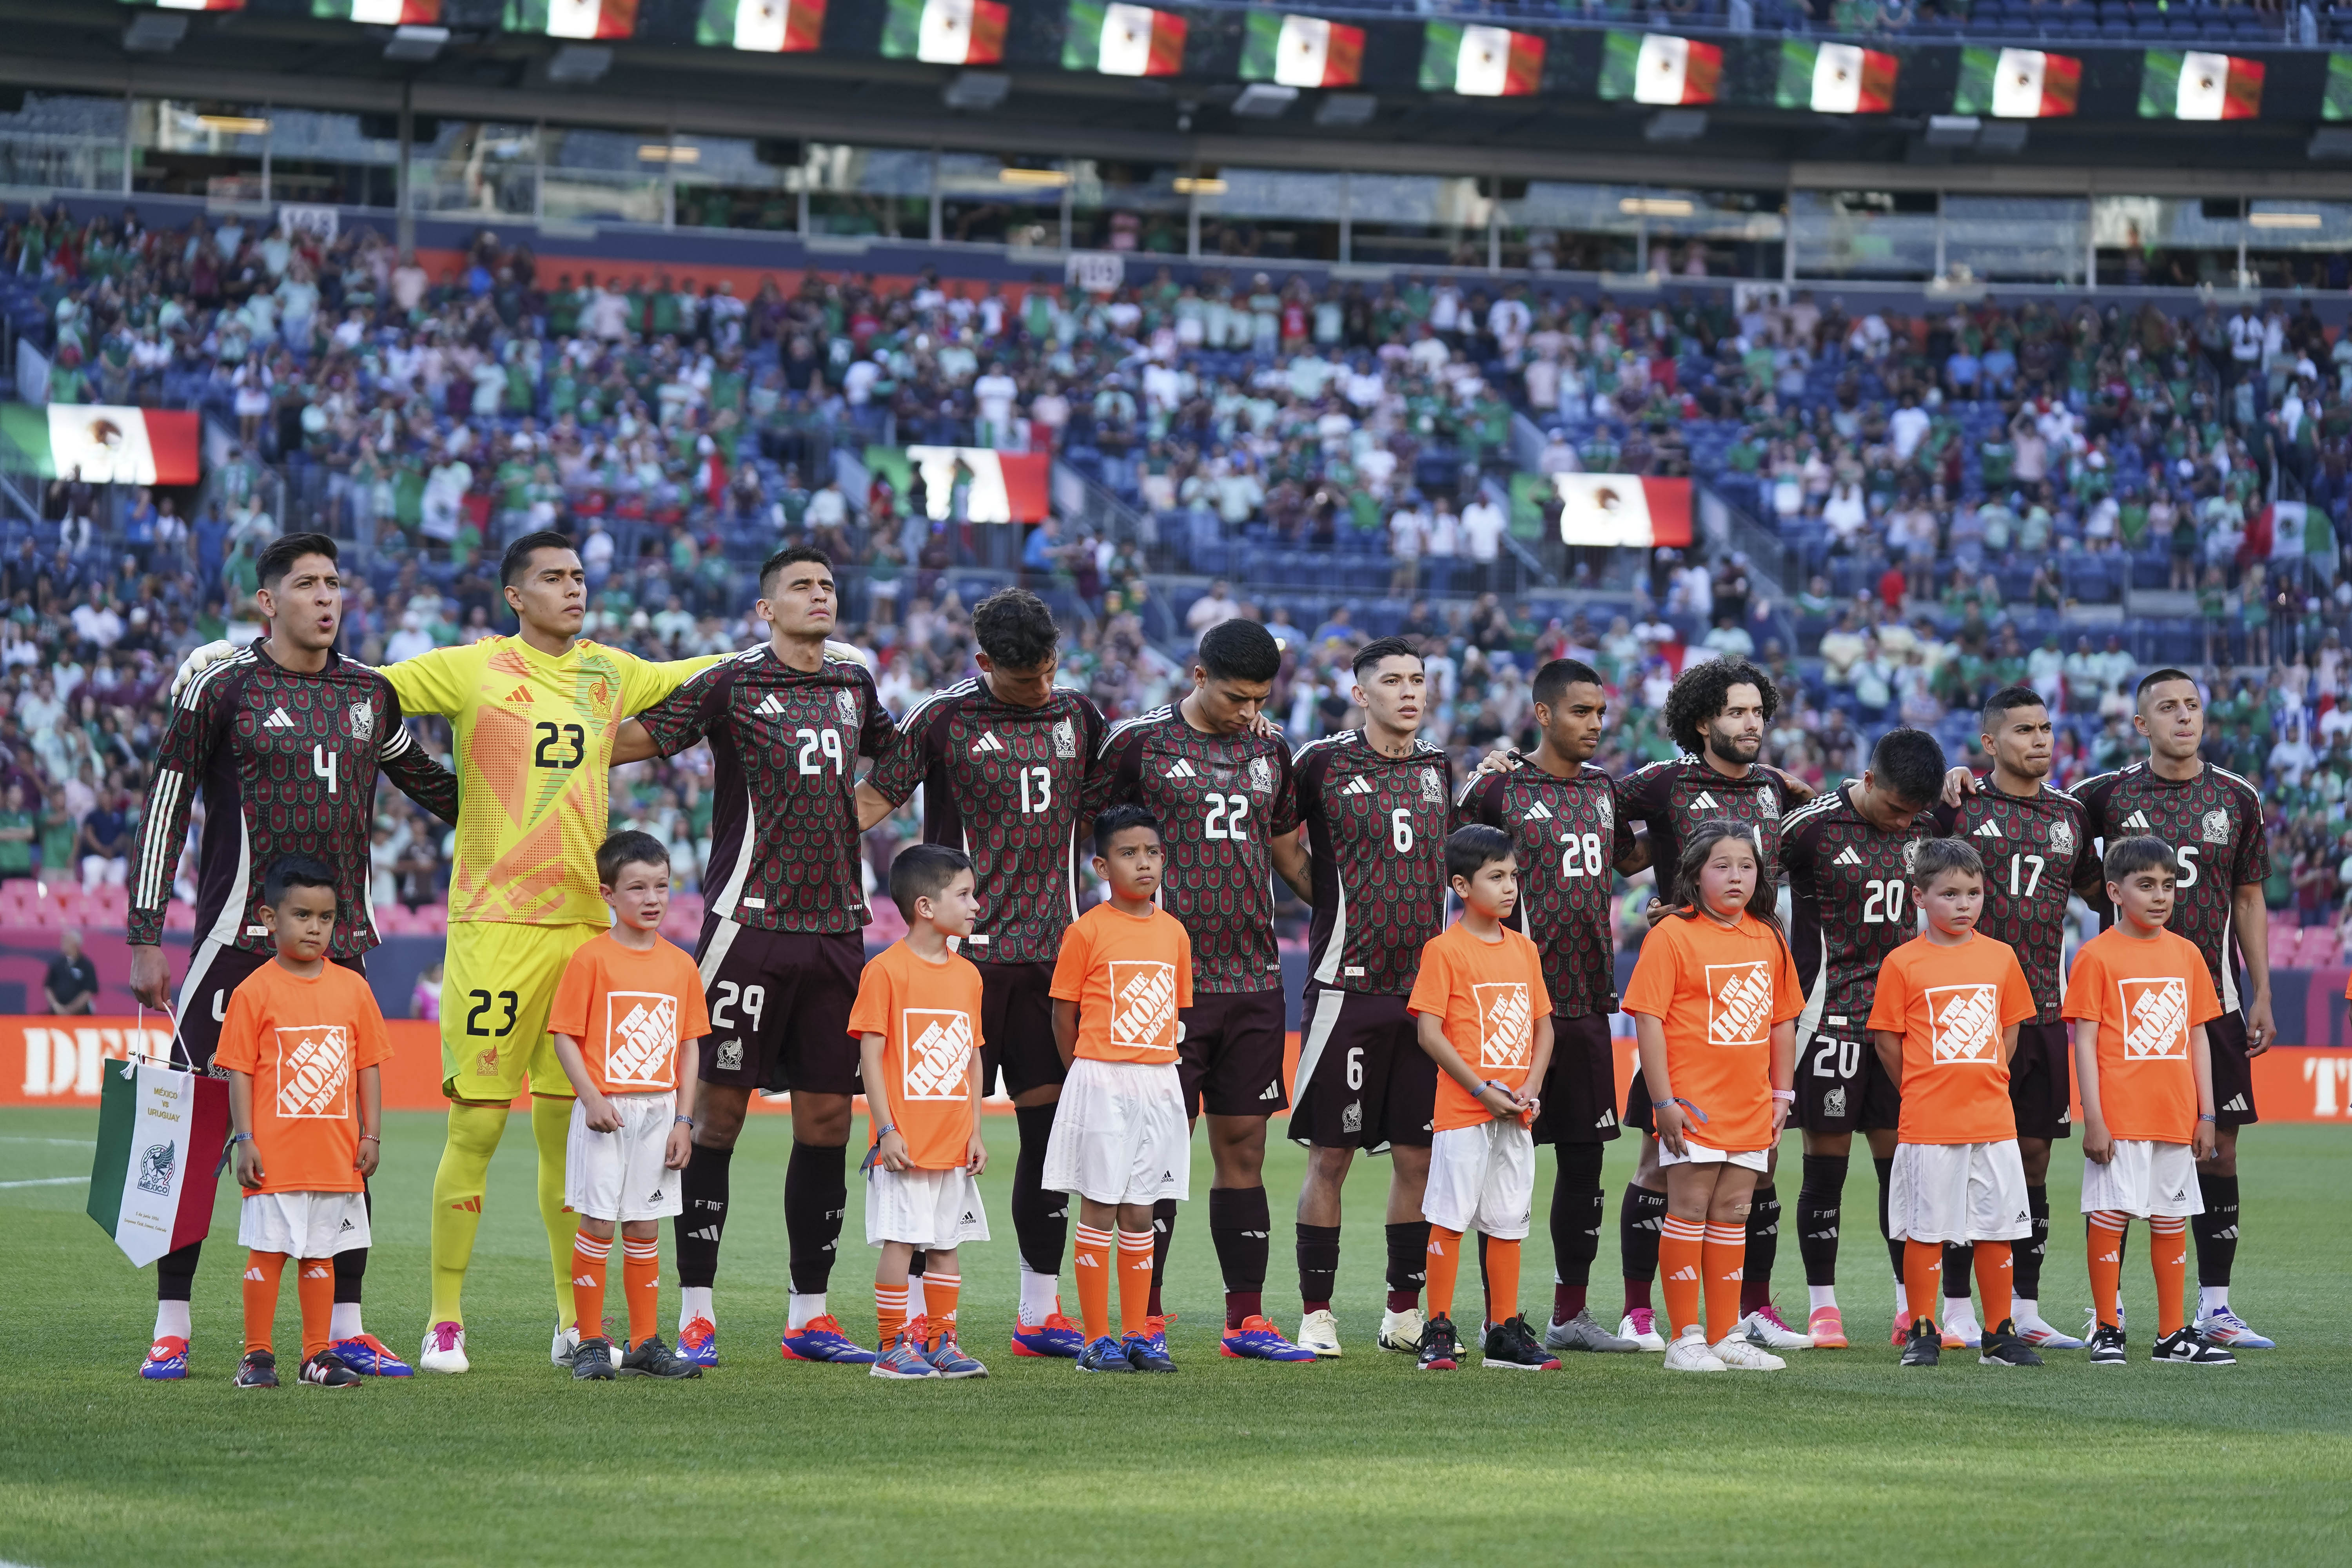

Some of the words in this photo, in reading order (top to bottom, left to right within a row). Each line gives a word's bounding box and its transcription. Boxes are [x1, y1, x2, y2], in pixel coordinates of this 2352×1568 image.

[535, 722, 584, 768] 23
[796, 728, 842, 775] 29
[314, 744, 337, 793] 4
[1020, 766, 1051, 813] 13
[1205, 793, 1248, 840] 22
[1392, 808, 1413, 853] 6
[1560, 833, 1602, 877] 28
[2053, 845, 2072, 853] MÉXICO
[2011, 853, 2045, 896] 17
[1864, 879, 1905, 922] 20
[712, 980, 764, 1031] 29
[1113, 965, 1173, 1043] HOME
[1120, 972, 1150, 1003] THE
[1487, 993, 1509, 1025] THE
[1711, 963, 1771, 1042] HOME
[1718, 974, 1743, 1004] THE
[1938, 995, 1967, 1026] THE
[2131, 988, 2157, 1020] THE
[466, 989, 518, 1036] 23
[615, 1002, 648, 1038] THE
[1141, 998, 1174, 1045] DEPOT
[1484, 985, 1529, 1065] HOME
[1740, 992, 1773, 1042] DEPOT
[1936, 987, 1995, 1059] HOME
[2127, 981, 2186, 1056] HOME
[2154, 1009, 2186, 1055] DEPOT
[285, 1037, 317, 1072] THE
[609, 998, 675, 1080] HOME
[637, 1029, 675, 1080] DEPOT
[907, 1014, 971, 1096] HOME
[912, 1020, 944, 1056] THE
[1813, 1035, 1860, 1078] 20
[1962, 1014, 1995, 1059] DEPOT
[279, 1028, 345, 1114] HOME
[308, 1060, 348, 1115] DEPOT
[935, 1044, 971, 1096] DEPOT
[1347, 1047, 1364, 1091] 6
[148, 1107, 180, 1122] URUGUAY
[154, 1087, 178, 1099] MÉXICO
[139, 1180, 167, 1194] MÉXICO
